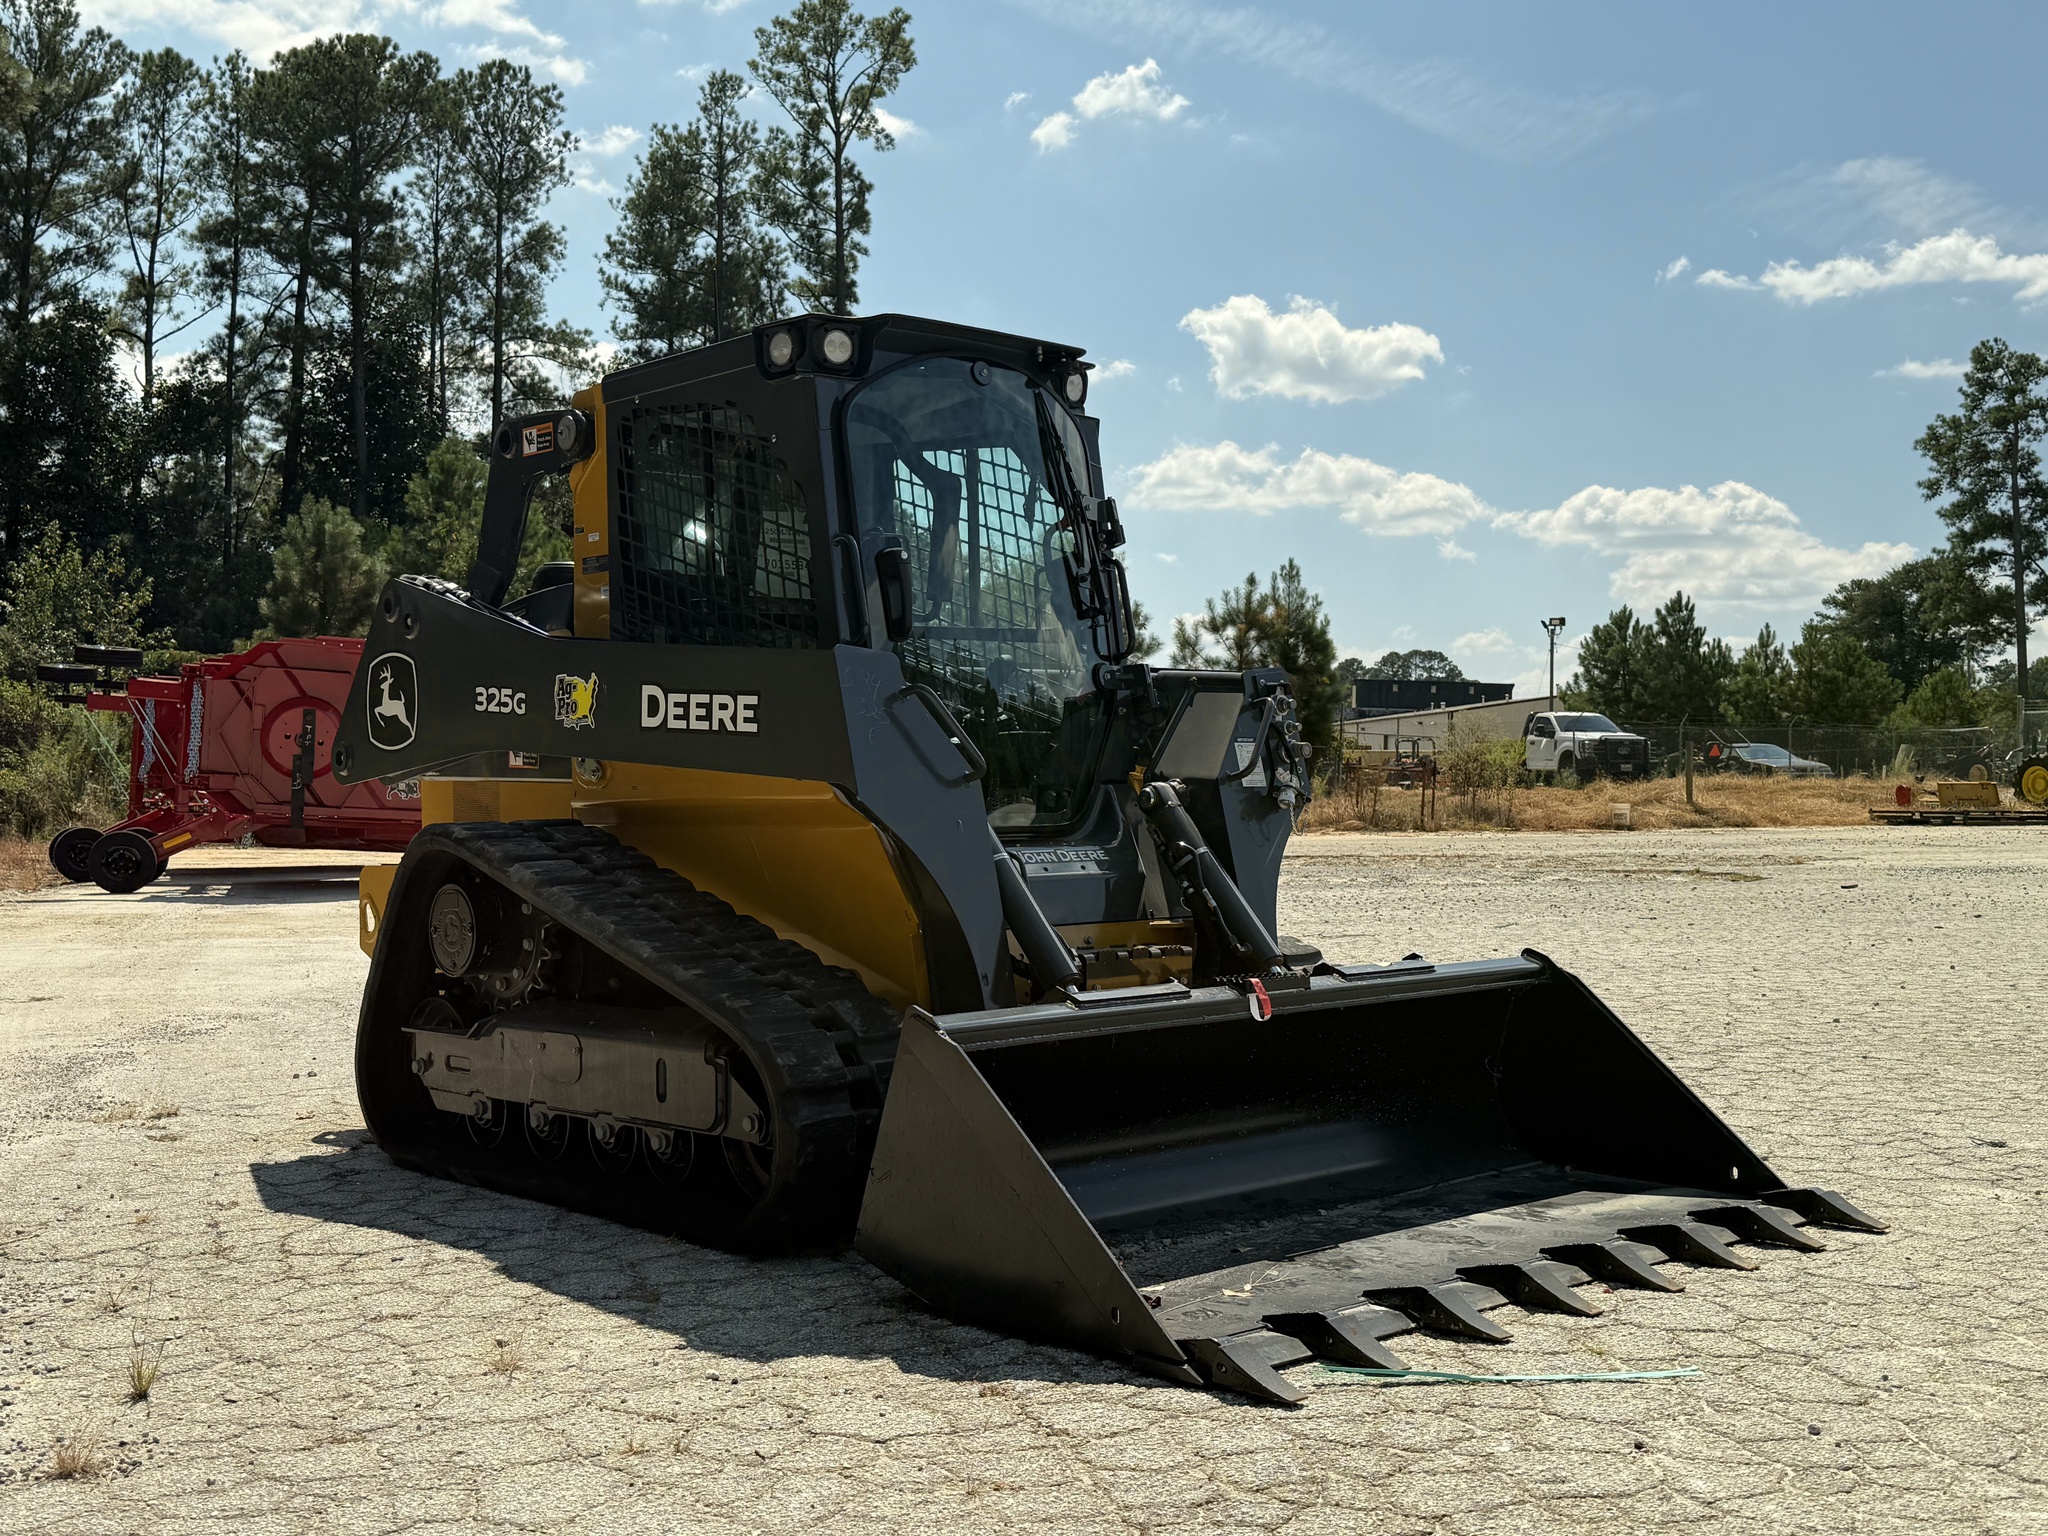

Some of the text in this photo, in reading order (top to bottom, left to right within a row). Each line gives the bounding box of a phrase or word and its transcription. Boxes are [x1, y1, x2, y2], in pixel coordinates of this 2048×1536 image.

[474, 686, 527, 716] 325G
[557, 678, 578, 701] Ag-
[557, 697, 578, 717] Pro
[641, 684, 759, 733] DEERE
[1017, 849, 1110, 864] JOHN DEERE
